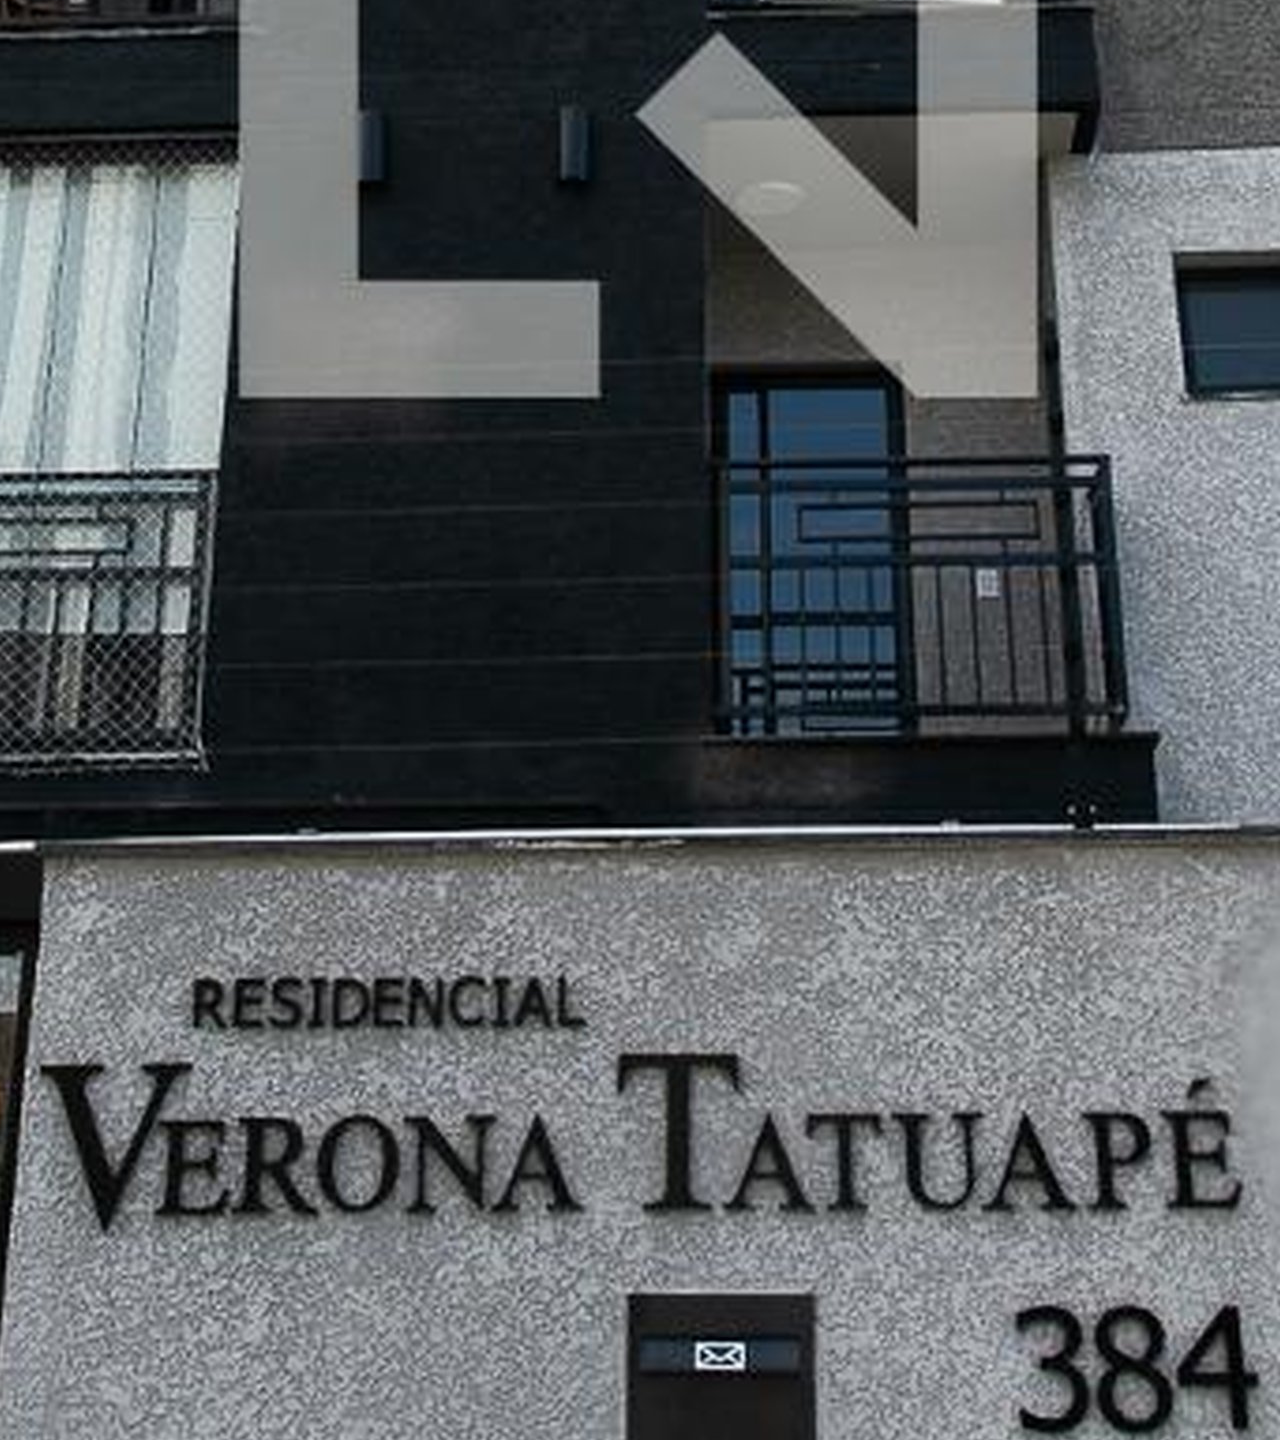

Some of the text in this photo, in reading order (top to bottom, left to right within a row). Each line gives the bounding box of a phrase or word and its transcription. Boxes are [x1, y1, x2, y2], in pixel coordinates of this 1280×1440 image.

[191, 977, 586, 1031] RESIDENCIAL
[42, 1059, 584, 1232] VERONA
[617, 1052, 1244, 1218] TATUAPÉ
[1016, 1305, 1260, 1432] 384
